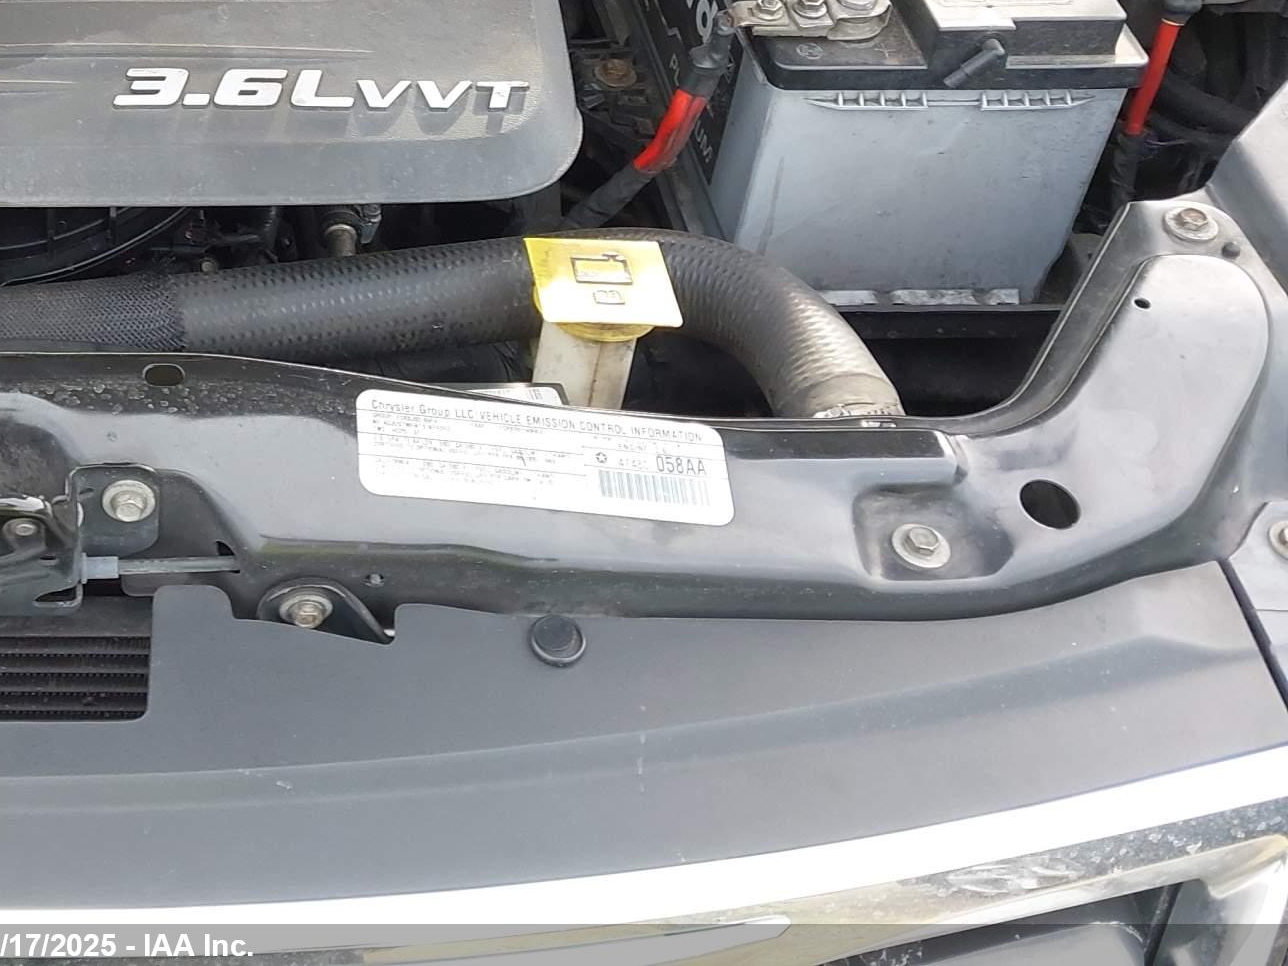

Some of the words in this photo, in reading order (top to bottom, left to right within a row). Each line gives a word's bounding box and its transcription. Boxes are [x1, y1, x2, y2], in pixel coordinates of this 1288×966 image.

[371, 399, 414, 413] Chrysler
[419, 404, 450, 418] Group
[455, 409, 474, 419] LLC
[480, 410, 521, 425] VEHICLE
[526, 414, 575, 430] EMISSION
[580, 421, 627, 435] CONTROL
[631, 427, 703, 442] INFORMATION
